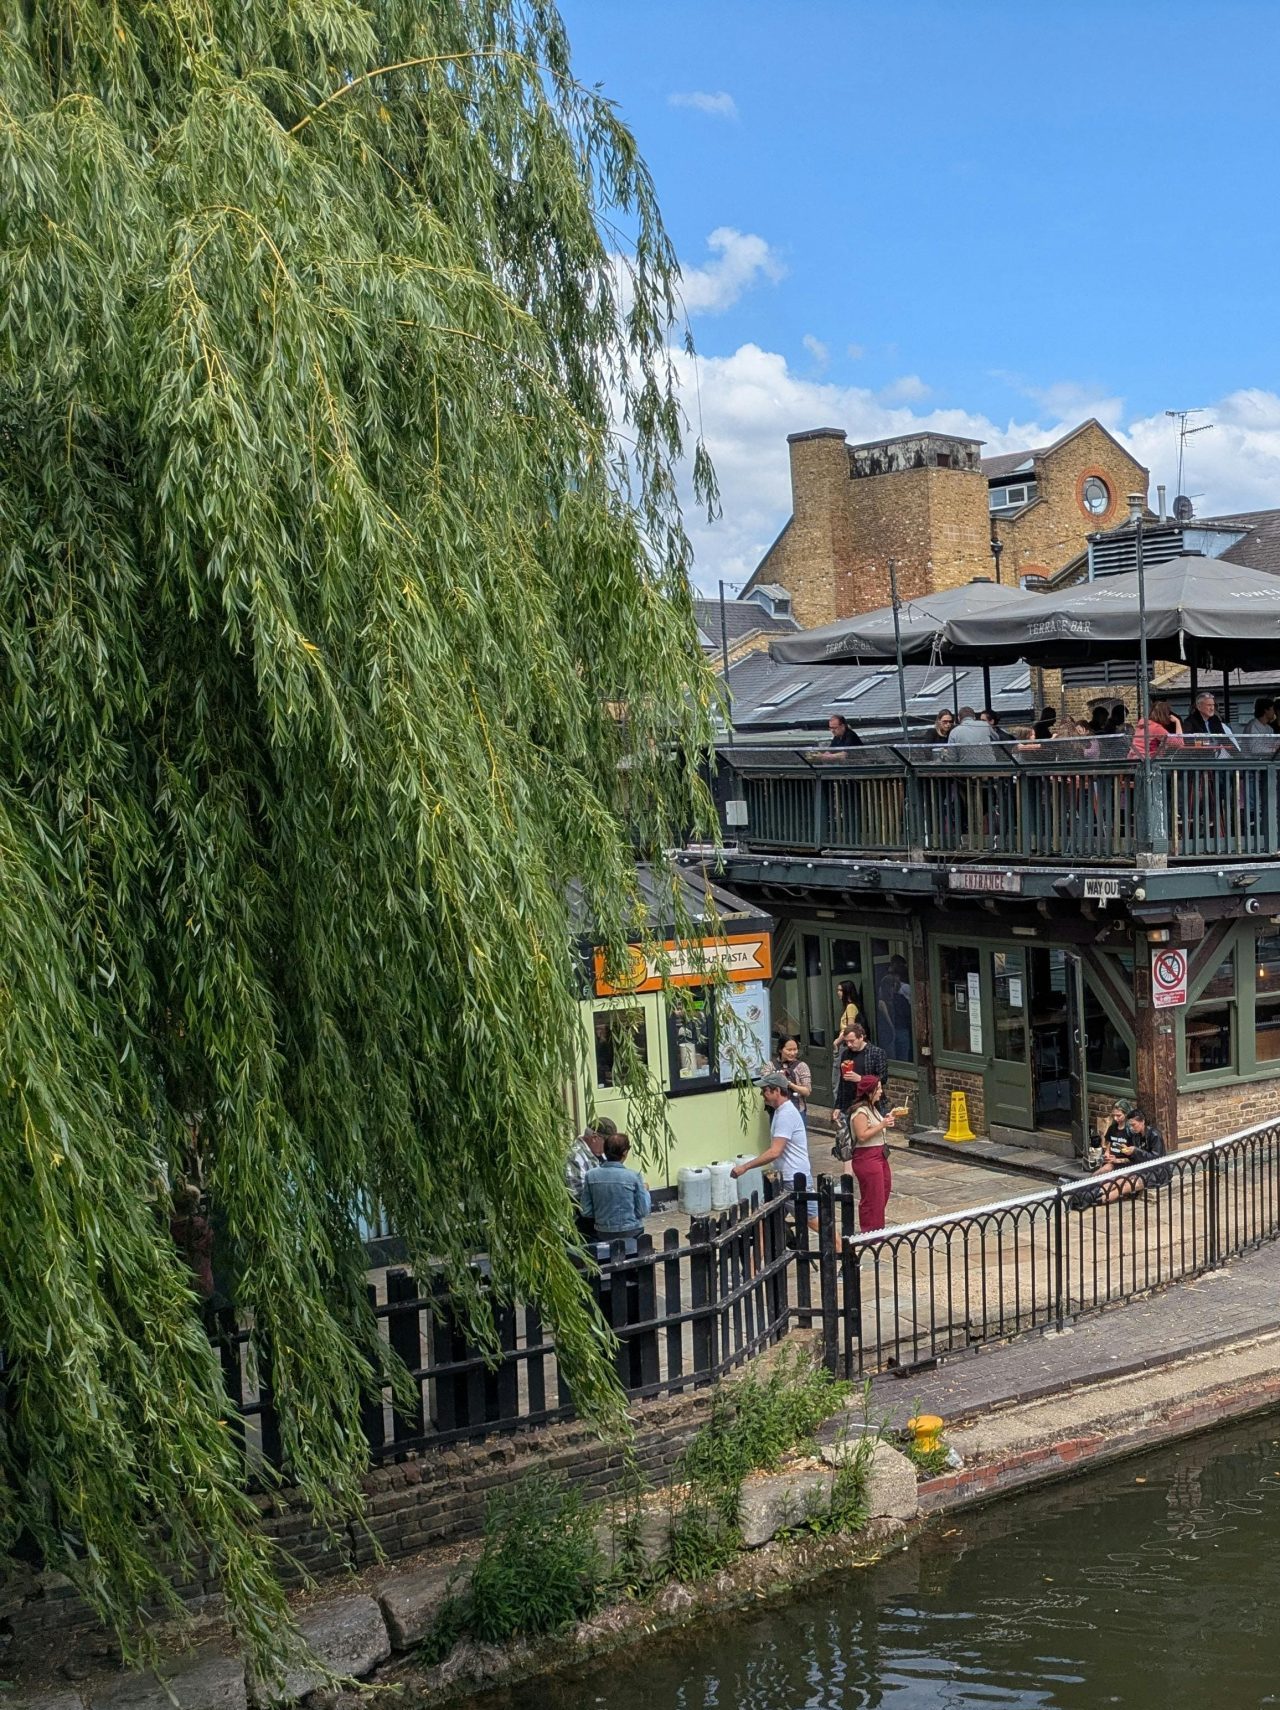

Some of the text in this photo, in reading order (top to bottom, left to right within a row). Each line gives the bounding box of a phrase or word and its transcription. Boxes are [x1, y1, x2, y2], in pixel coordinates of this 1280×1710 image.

[1026, 619, 1091, 635] TERRACE BAR
[964, 874, 1004, 890] ENTRANCE
[1086, 881, 1103, 895] WAY
[721, 952, 748, 962] PASTA
